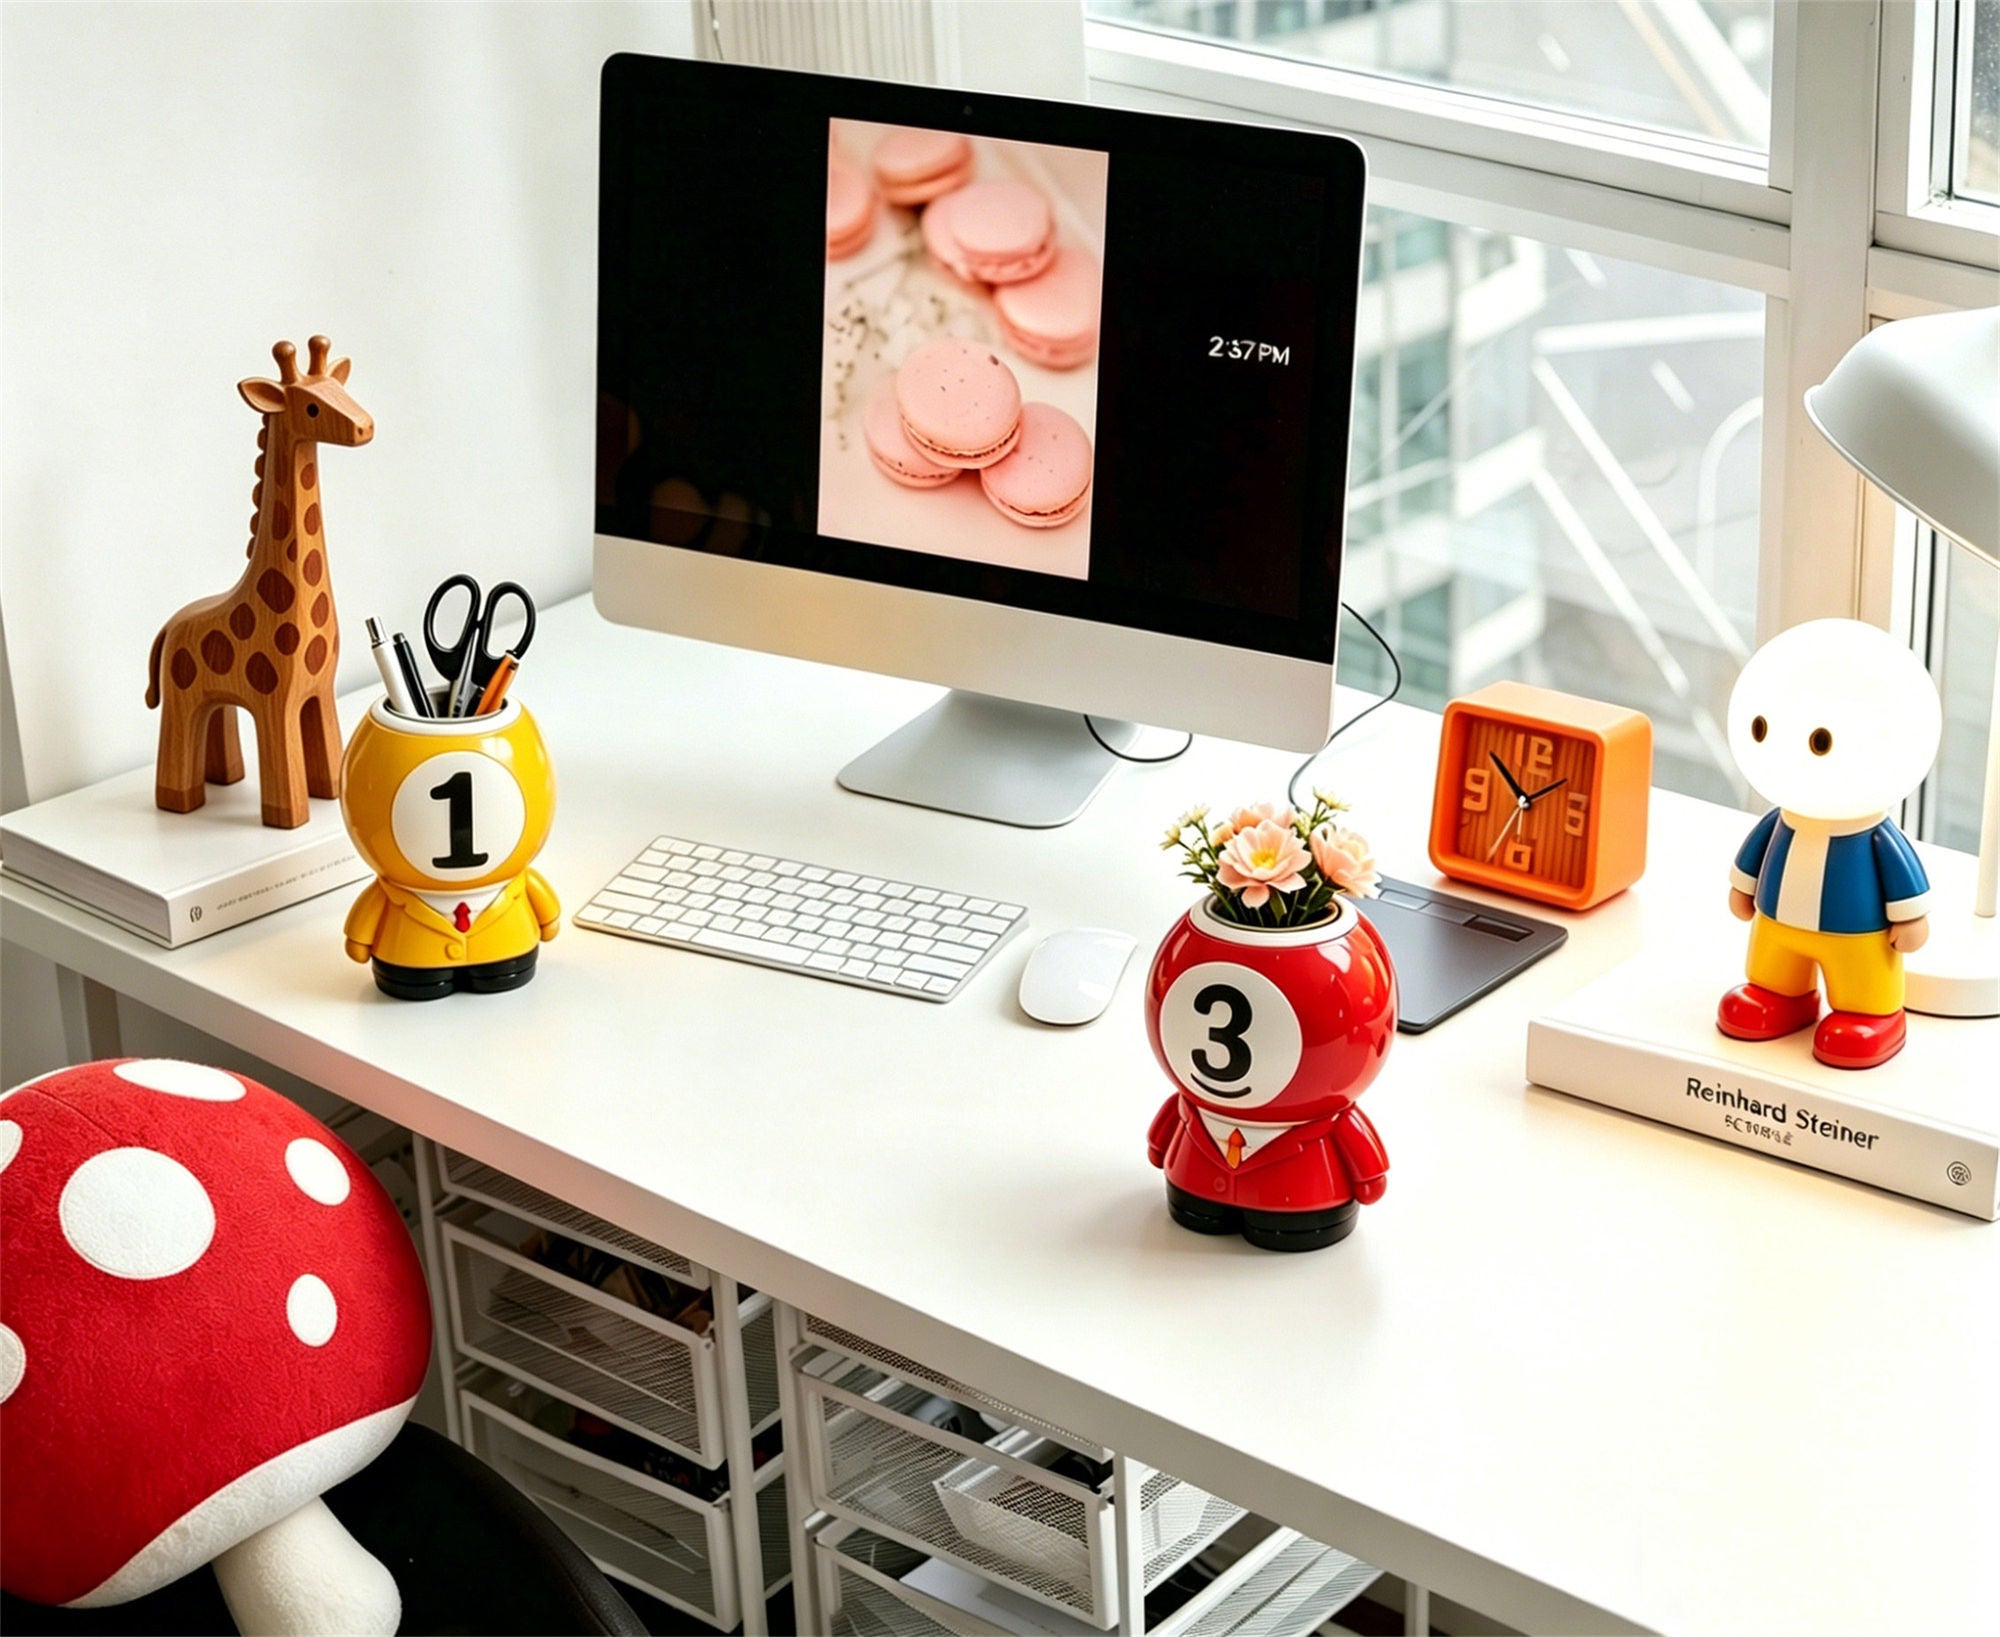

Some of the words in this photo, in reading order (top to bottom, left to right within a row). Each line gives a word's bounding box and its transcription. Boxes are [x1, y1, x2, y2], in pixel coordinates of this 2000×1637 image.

[430, 772, 488, 868] 1
[1462, 768, 1491, 811] 9
[1192, 984, 1252, 1082] 3
[1686, 1077, 1787, 1123] Reinhard
[1795, 1109, 1879, 1149] Steiner
